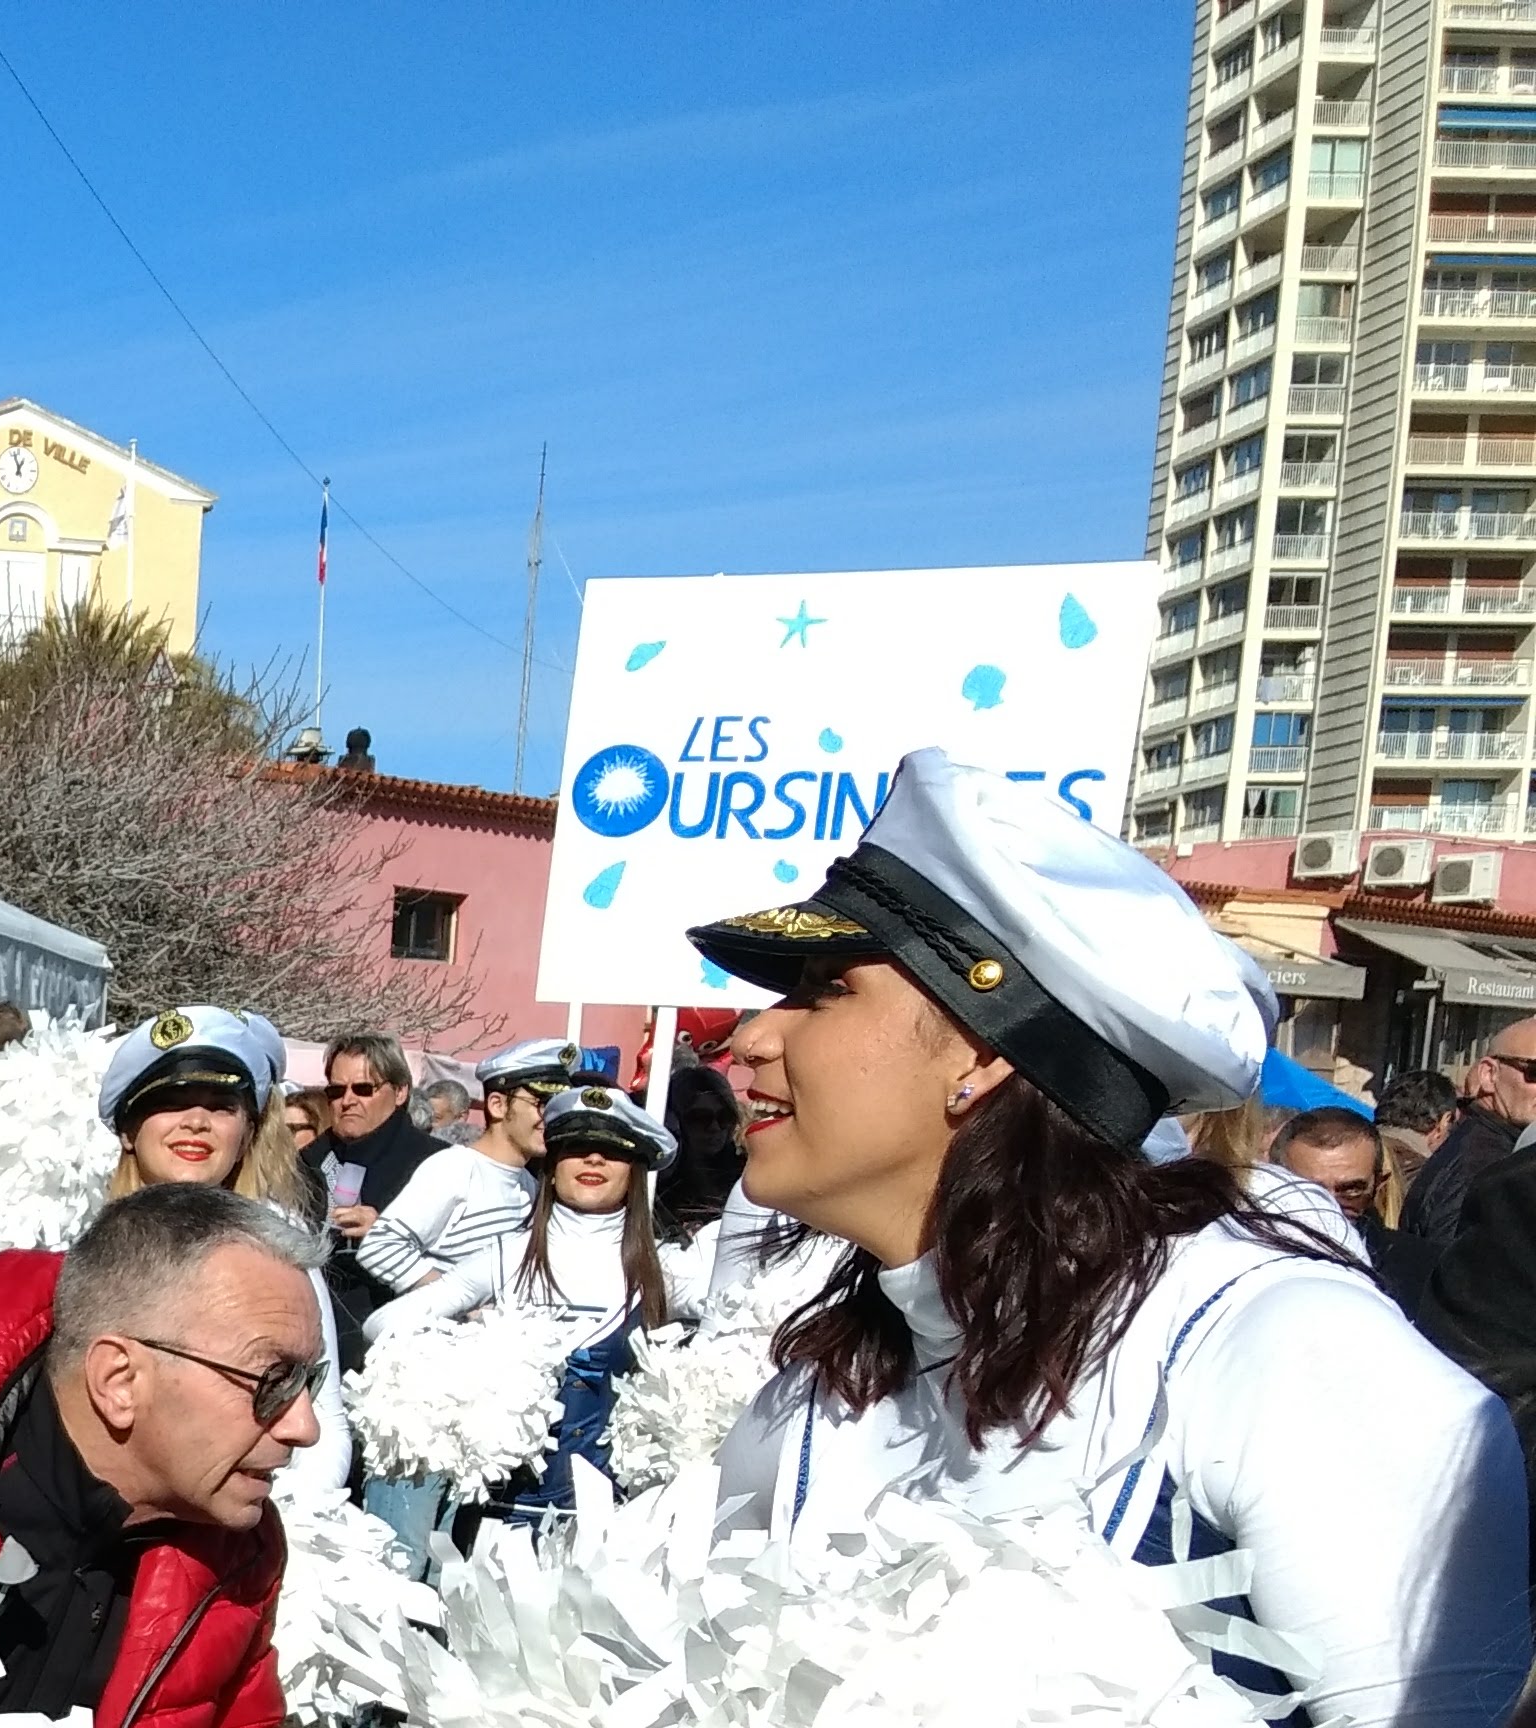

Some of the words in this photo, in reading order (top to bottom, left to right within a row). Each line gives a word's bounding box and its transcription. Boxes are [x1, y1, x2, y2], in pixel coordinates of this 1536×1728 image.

[8, 428, 34, 448] DE
[43, 437, 91, 475] VILLE
[678, 715, 772, 763] LES
[1467, 977, 1535, 1000] Restaurant
